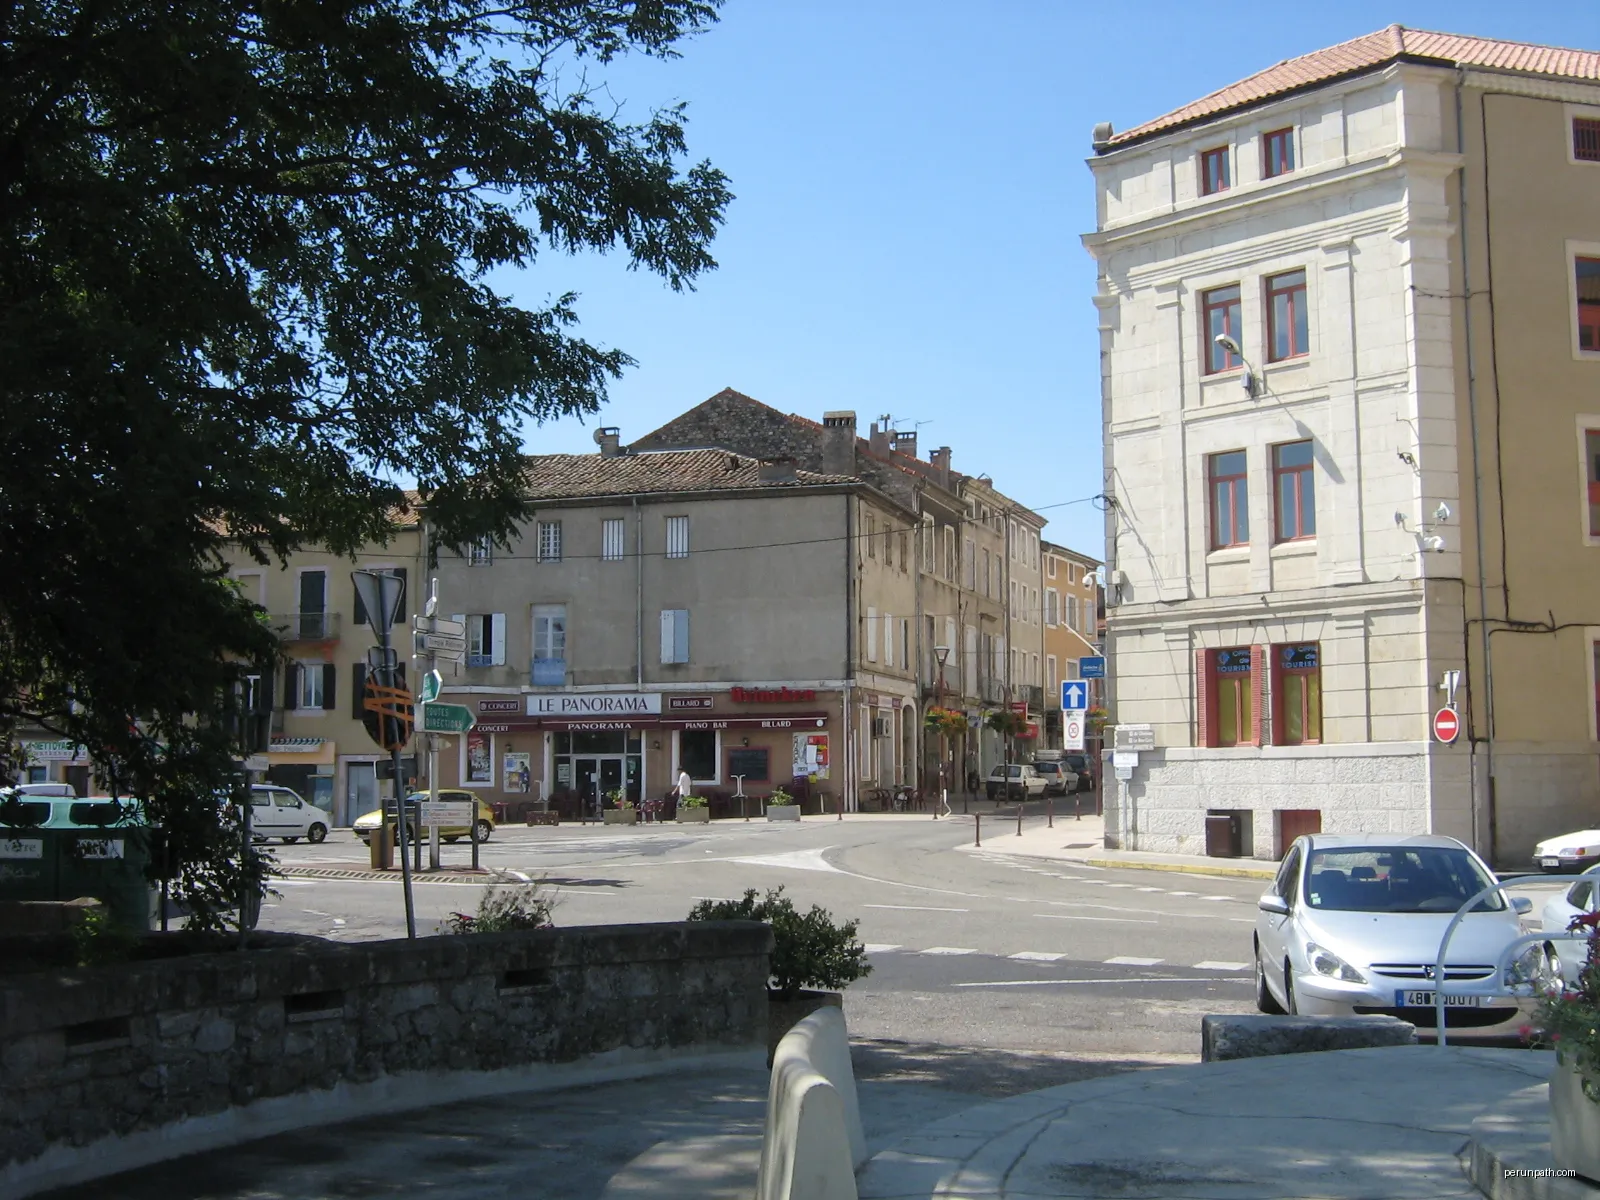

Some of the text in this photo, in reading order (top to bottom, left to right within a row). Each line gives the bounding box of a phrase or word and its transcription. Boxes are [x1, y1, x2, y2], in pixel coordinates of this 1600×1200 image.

[539, 697, 648, 712] LE PANORAMA
[426, 707, 449, 717] TOUTES
[426, 718, 463, 729] DIRECTIONS
[568, 722, 632, 730] PANORAMA
[761, 720, 791, 728] BILLARD
